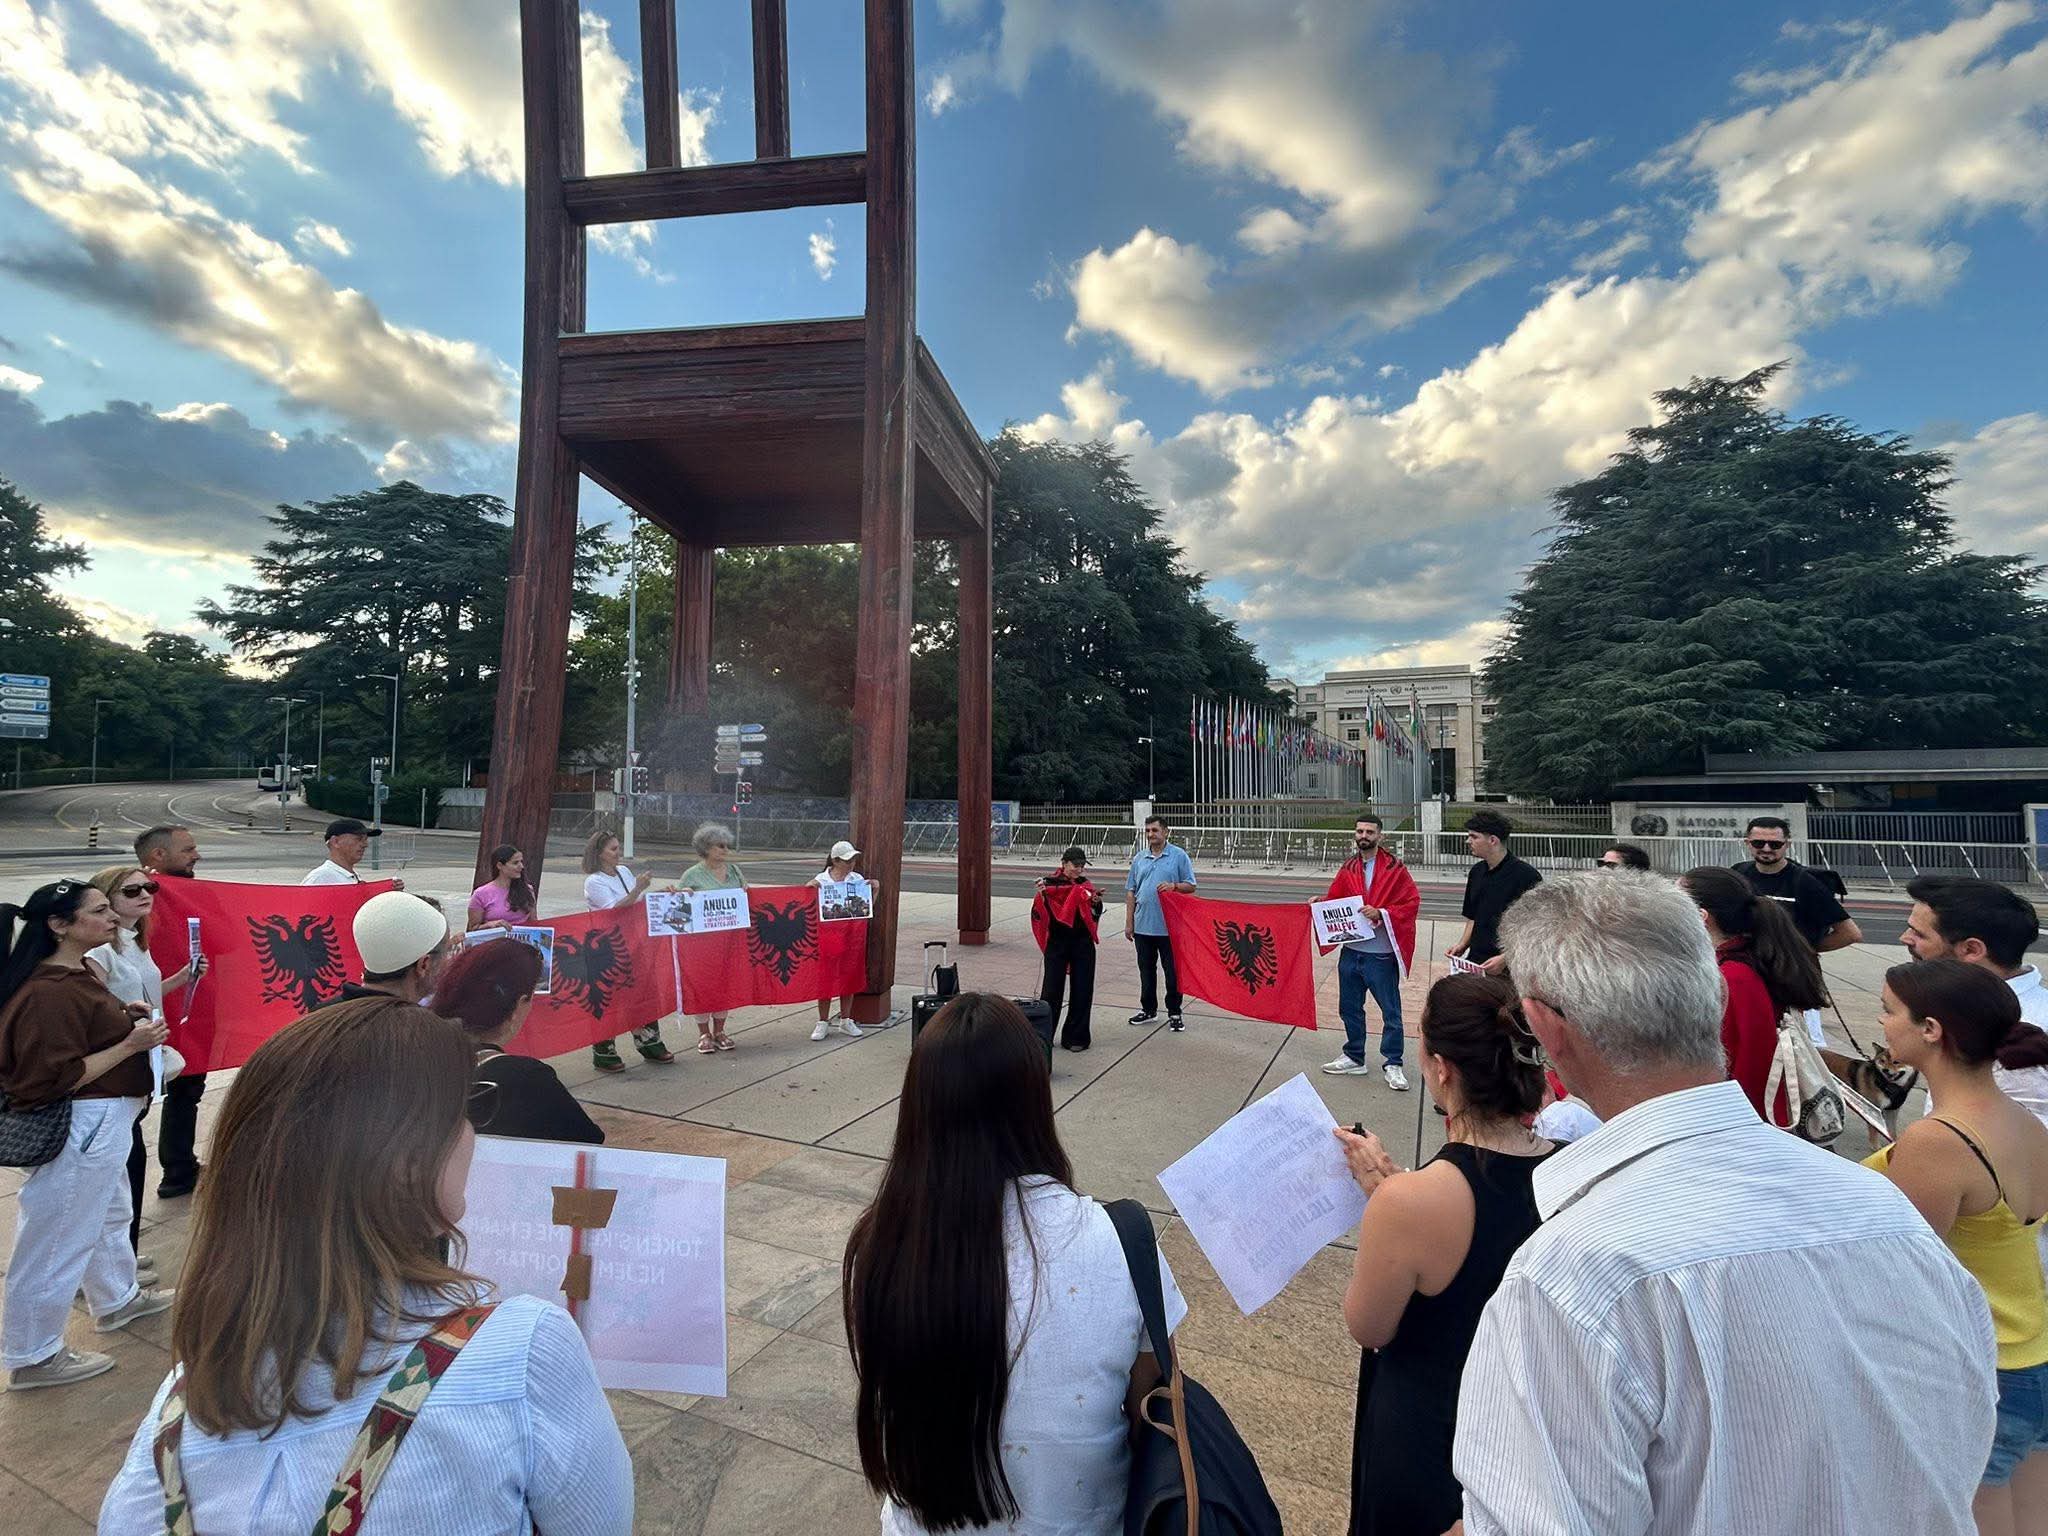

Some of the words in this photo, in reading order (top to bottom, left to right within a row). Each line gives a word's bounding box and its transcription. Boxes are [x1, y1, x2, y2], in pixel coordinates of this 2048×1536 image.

[1676, 817, 1737, 827] NATIONS
[1677, 830, 1724, 838] UNITED
[703, 897, 737, 911] ANULLO
[1322, 906, 1353, 920] ANULLO
[1327, 921, 1358, 932] MALEVE
